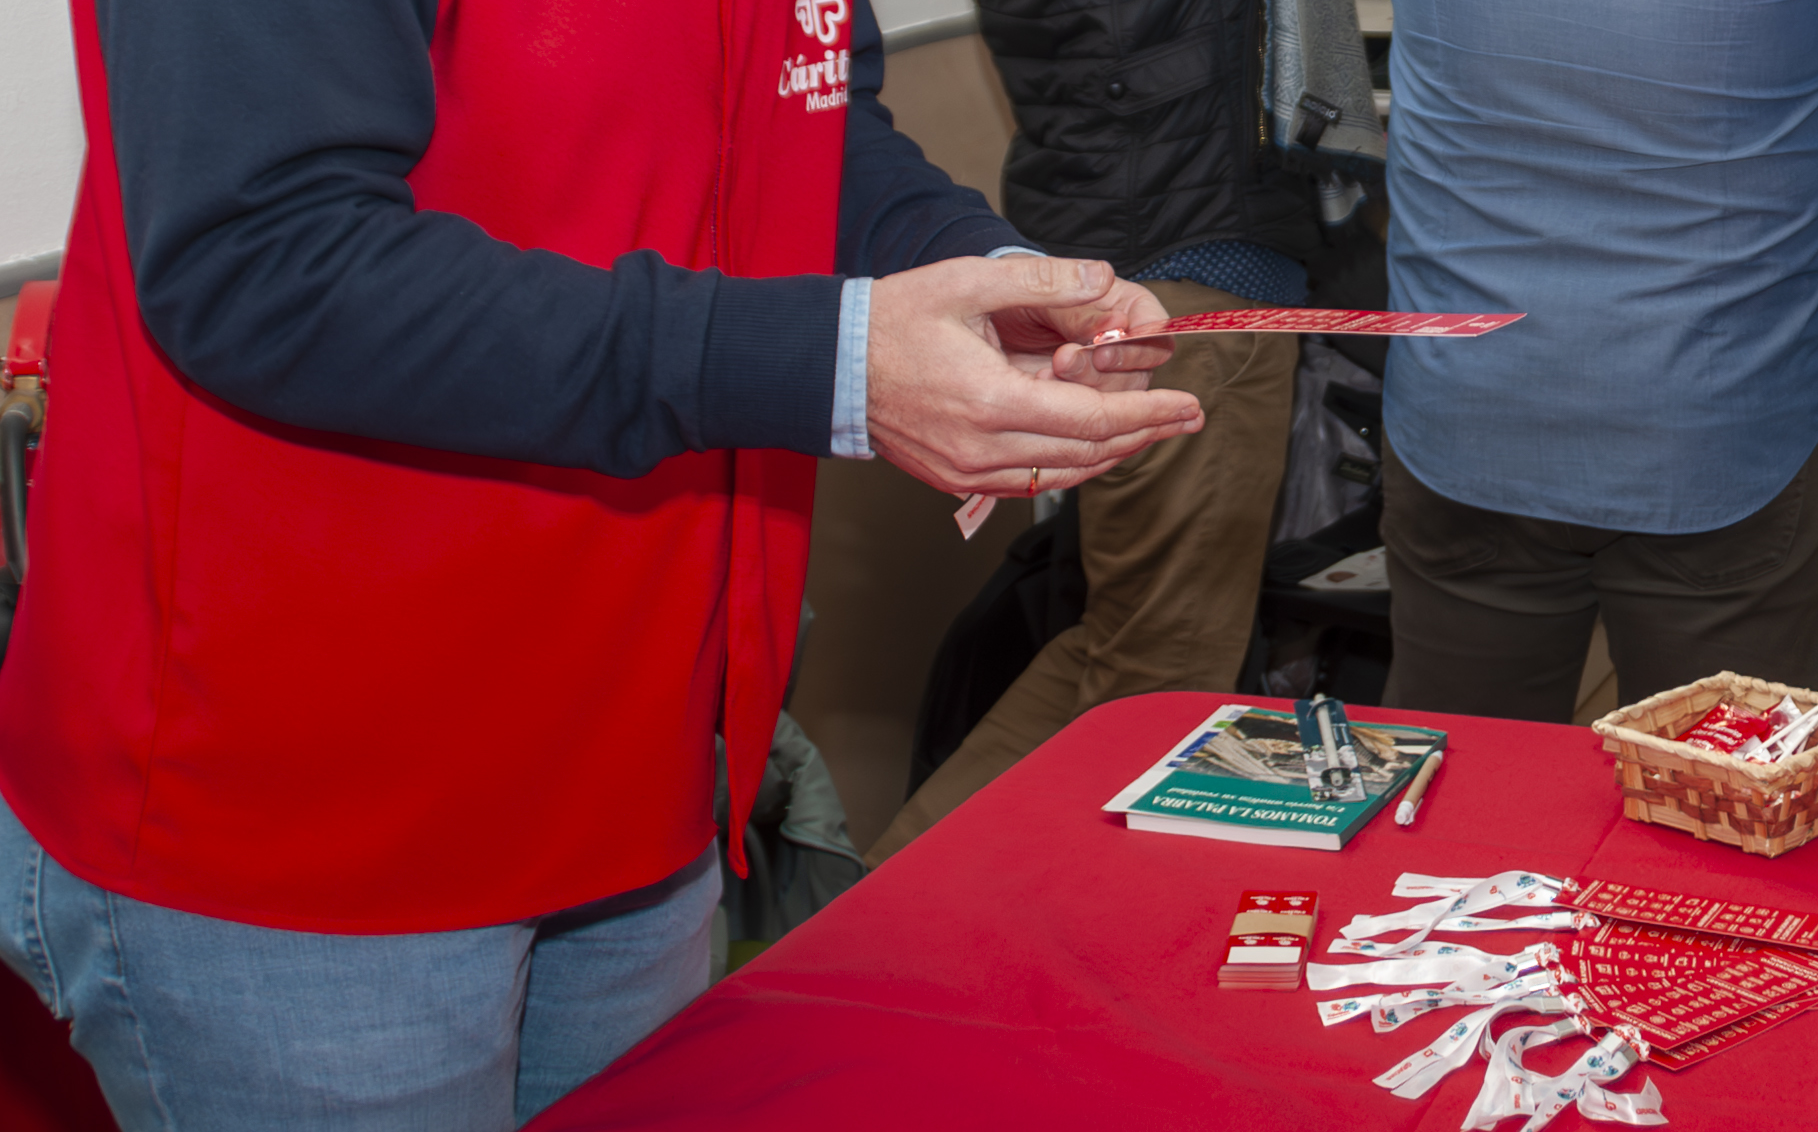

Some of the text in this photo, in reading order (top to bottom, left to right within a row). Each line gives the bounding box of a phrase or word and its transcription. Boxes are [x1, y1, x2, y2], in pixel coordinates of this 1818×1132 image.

[778, 49, 850, 96] Cárit
[1151, 795, 1339, 827] TOMAMOS LA PALABRA
